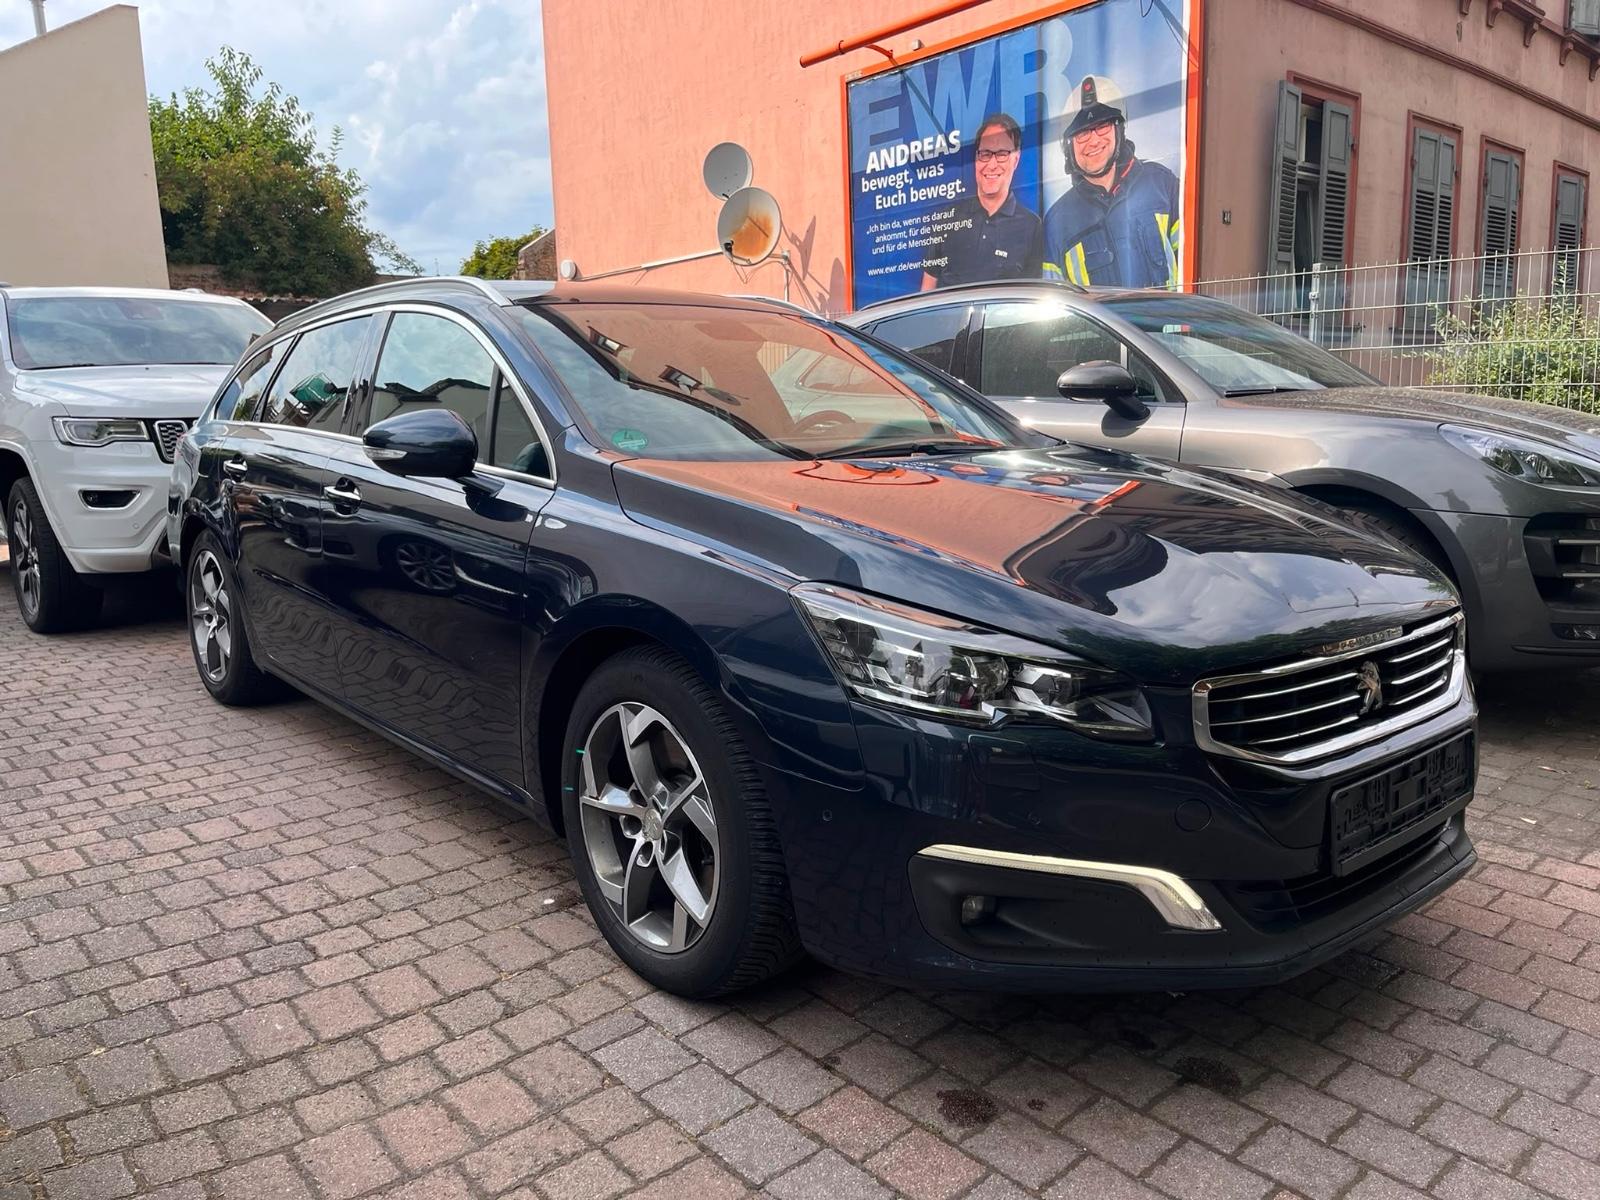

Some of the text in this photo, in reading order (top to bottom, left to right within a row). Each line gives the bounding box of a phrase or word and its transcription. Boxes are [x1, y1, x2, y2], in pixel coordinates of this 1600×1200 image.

[866, 130, 961, 174] ANDREAS
[861, 163, 944, 192] bewegt, was
[875, 179, 966, 210] Euch bewegt.
[875, 219, 973, 243] ankommt, für die Versorgung
[880, 222, 890, 231] bin
[902, 217, 921, 227] wenn
[922, 214, 930, 223] es
[931, 208, 955, 221] darauf
[872, 244, 885, 255] und
[886, 244, 896, 252] für
[896, 241, 907, 250] die
[867, 256, 949, 277] www.ewr.de/ewr-bewegt
